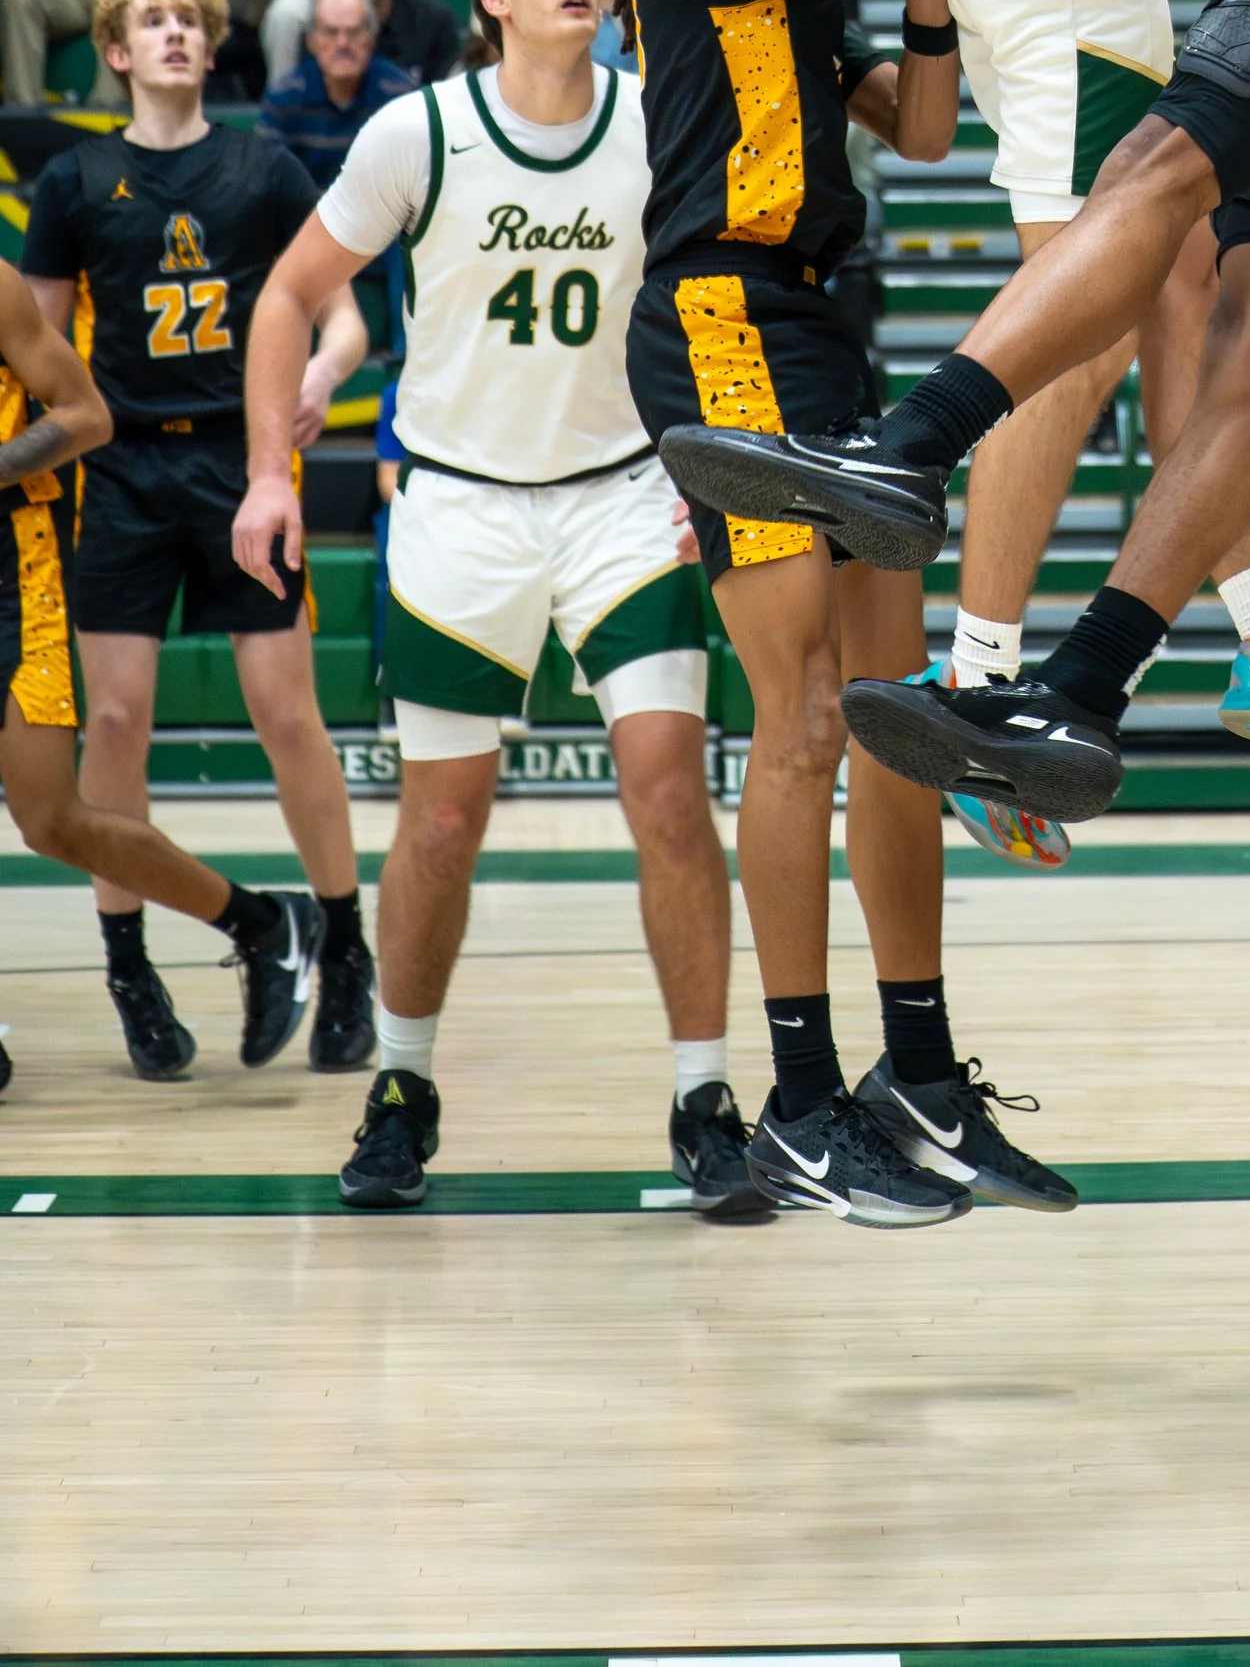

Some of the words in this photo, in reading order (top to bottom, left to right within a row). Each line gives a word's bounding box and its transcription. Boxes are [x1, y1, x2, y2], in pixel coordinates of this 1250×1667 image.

[479, 203, 615, 252] Rocks
[144, 278, 232, 358] 22
[486, 266, 601, 347] 40
[334, 744, 397, 780] ES
